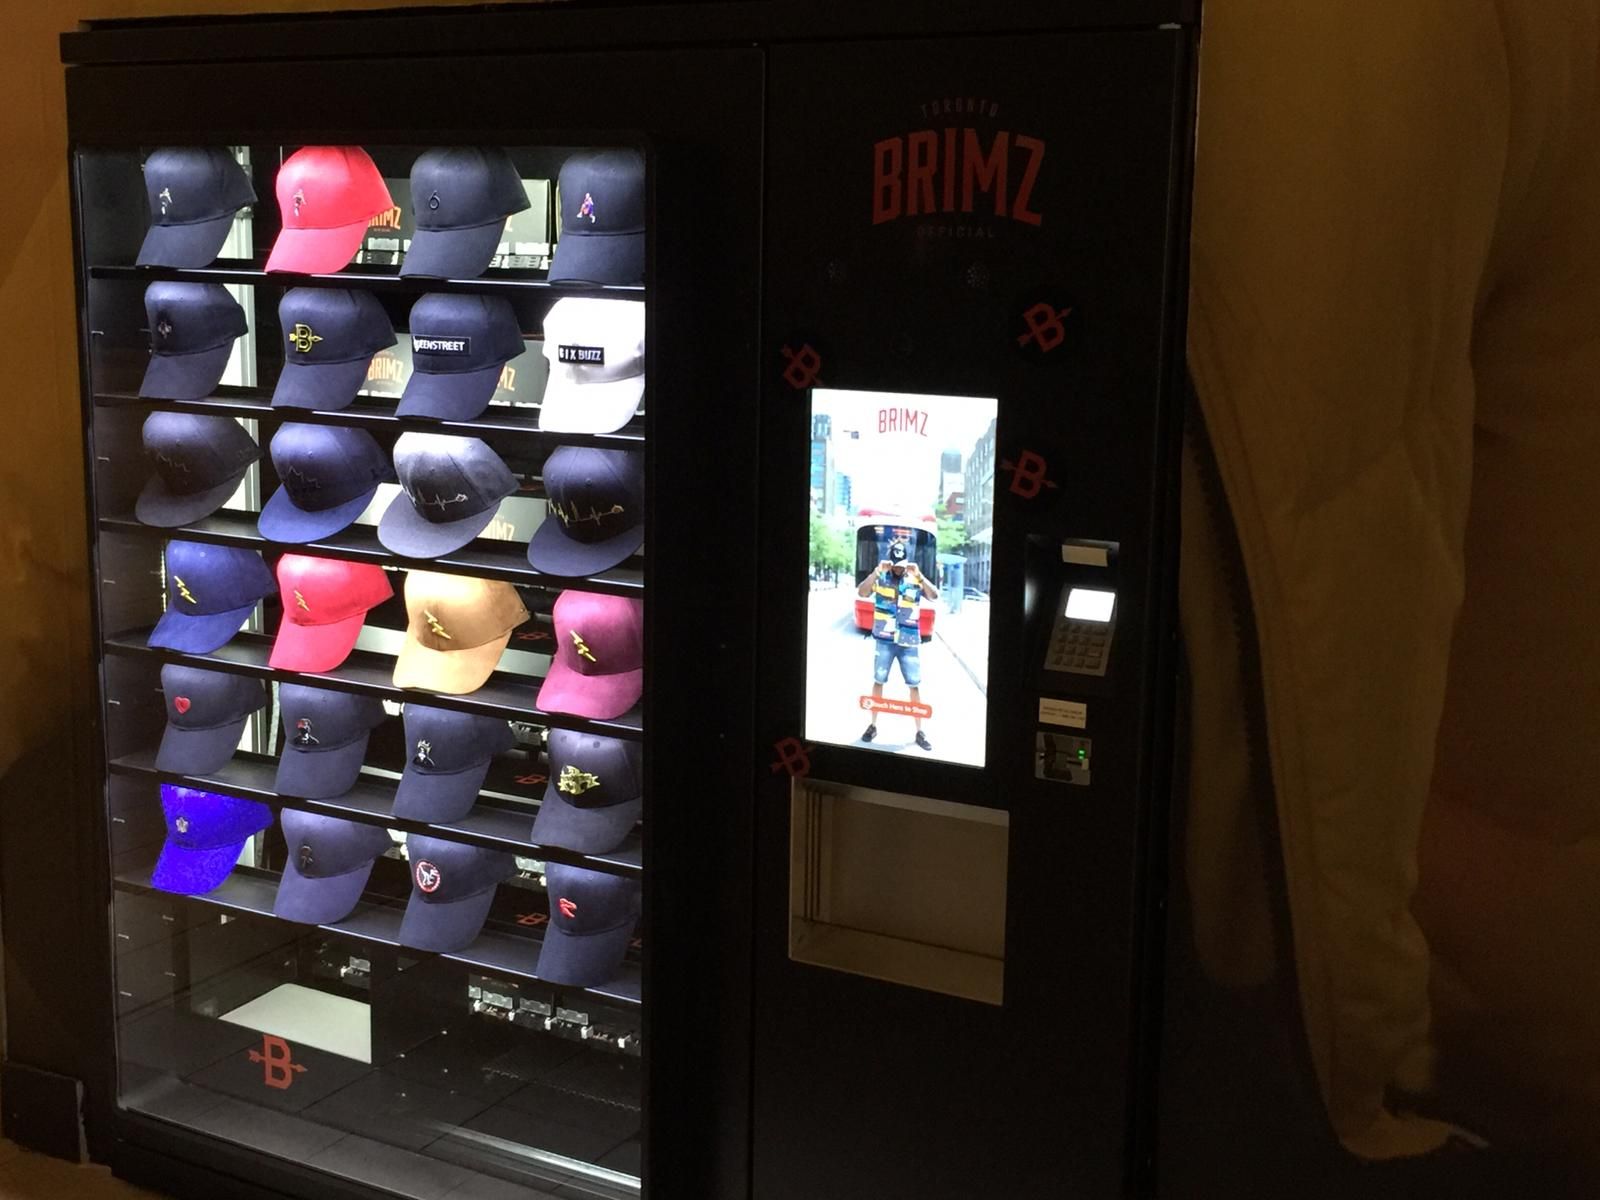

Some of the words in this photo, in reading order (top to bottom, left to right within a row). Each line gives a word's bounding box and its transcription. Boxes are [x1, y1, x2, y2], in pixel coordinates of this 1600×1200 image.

[920, 97, 999, 119] TORONTO
[872, 127, 1046, 226] BRIMZ
[578, 349, 602, 361] BUZZ
[878, 407, 929, 438] BRIMZ
